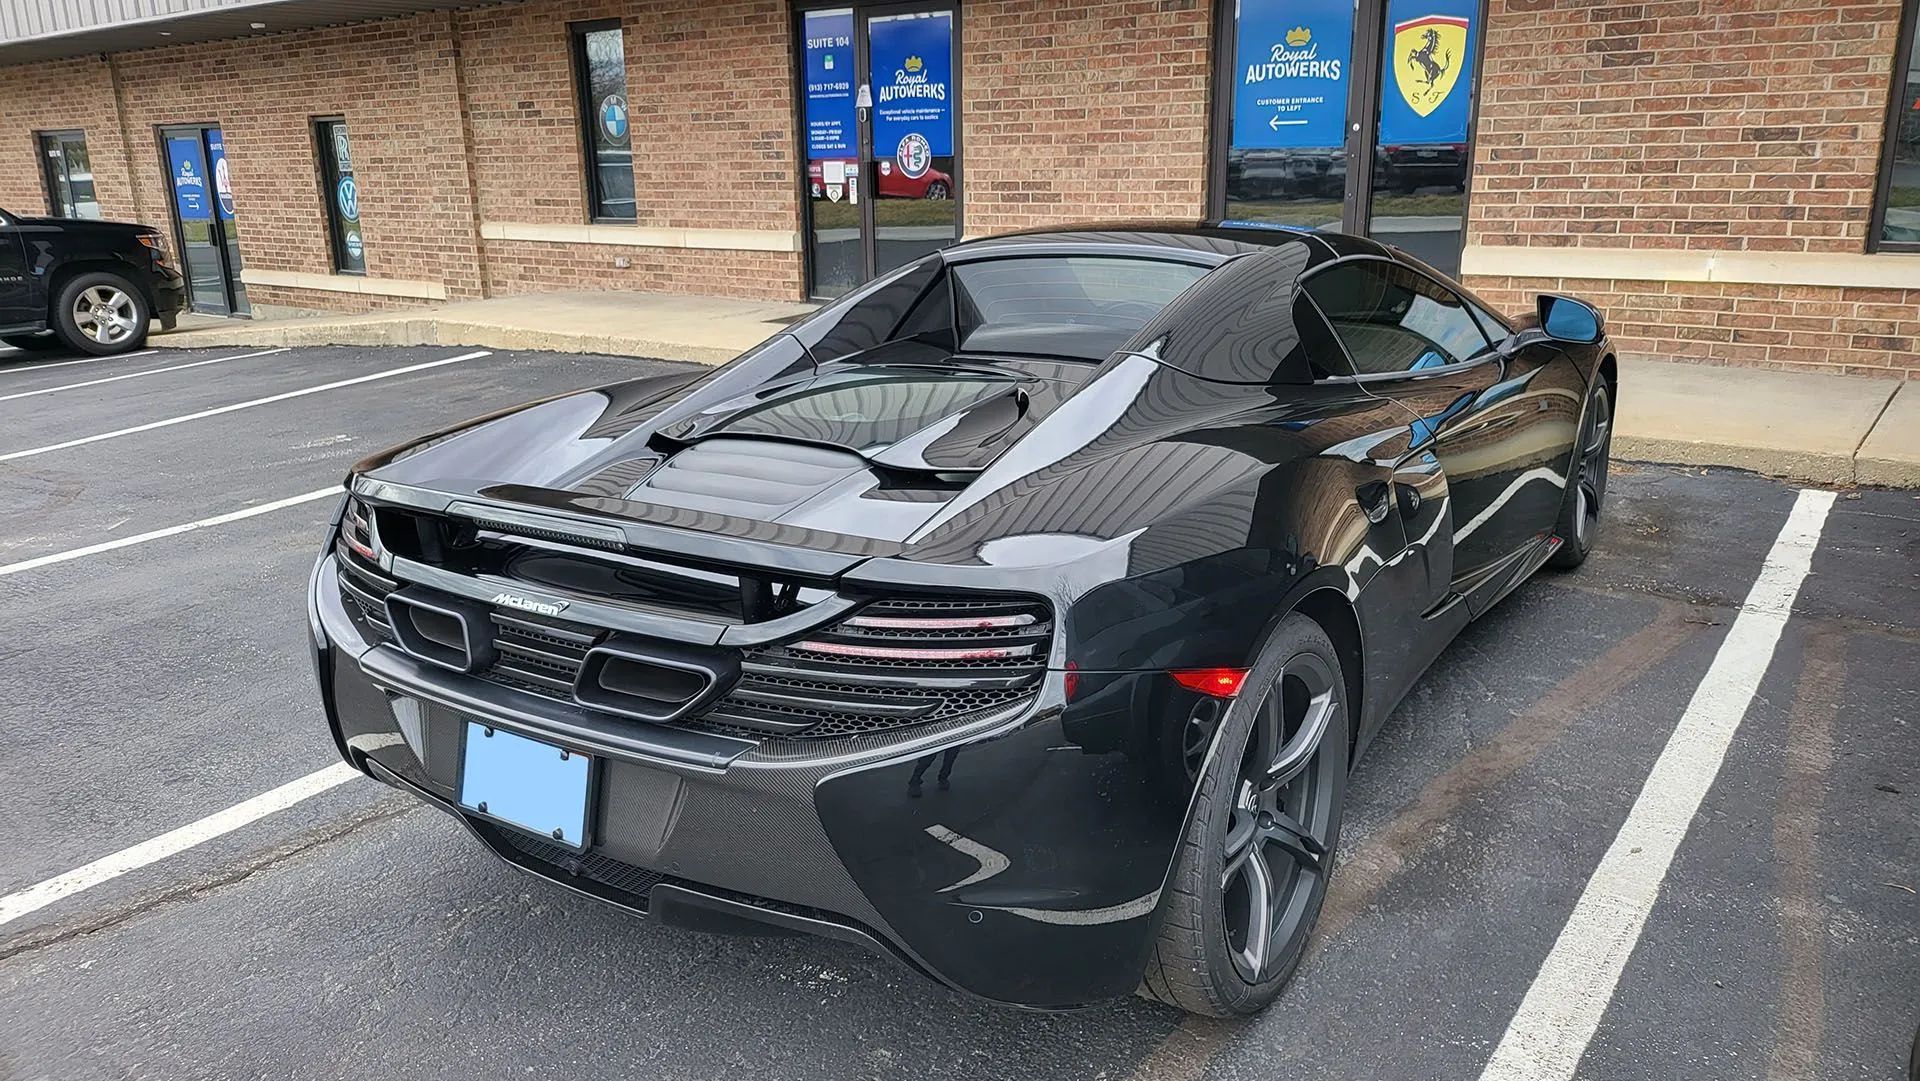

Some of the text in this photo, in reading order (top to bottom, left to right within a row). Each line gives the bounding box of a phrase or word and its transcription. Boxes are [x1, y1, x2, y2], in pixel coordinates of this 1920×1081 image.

[807, 36, 850, 49] SUITE 104
[1271, 43, 1317, 65] Royal
[895, 69, 928, 88] Royal
[1245, 60, 1341, 85] AUTOWERKS
[879, 83, 945, 103] AUTOWERKS
[1256, 98, 1290, 106] CUSTOMER
[1411, 92, 1420, 104] S
[602, 96, 627, 112] BMW
[491, 593, 559, 616] McLaren
